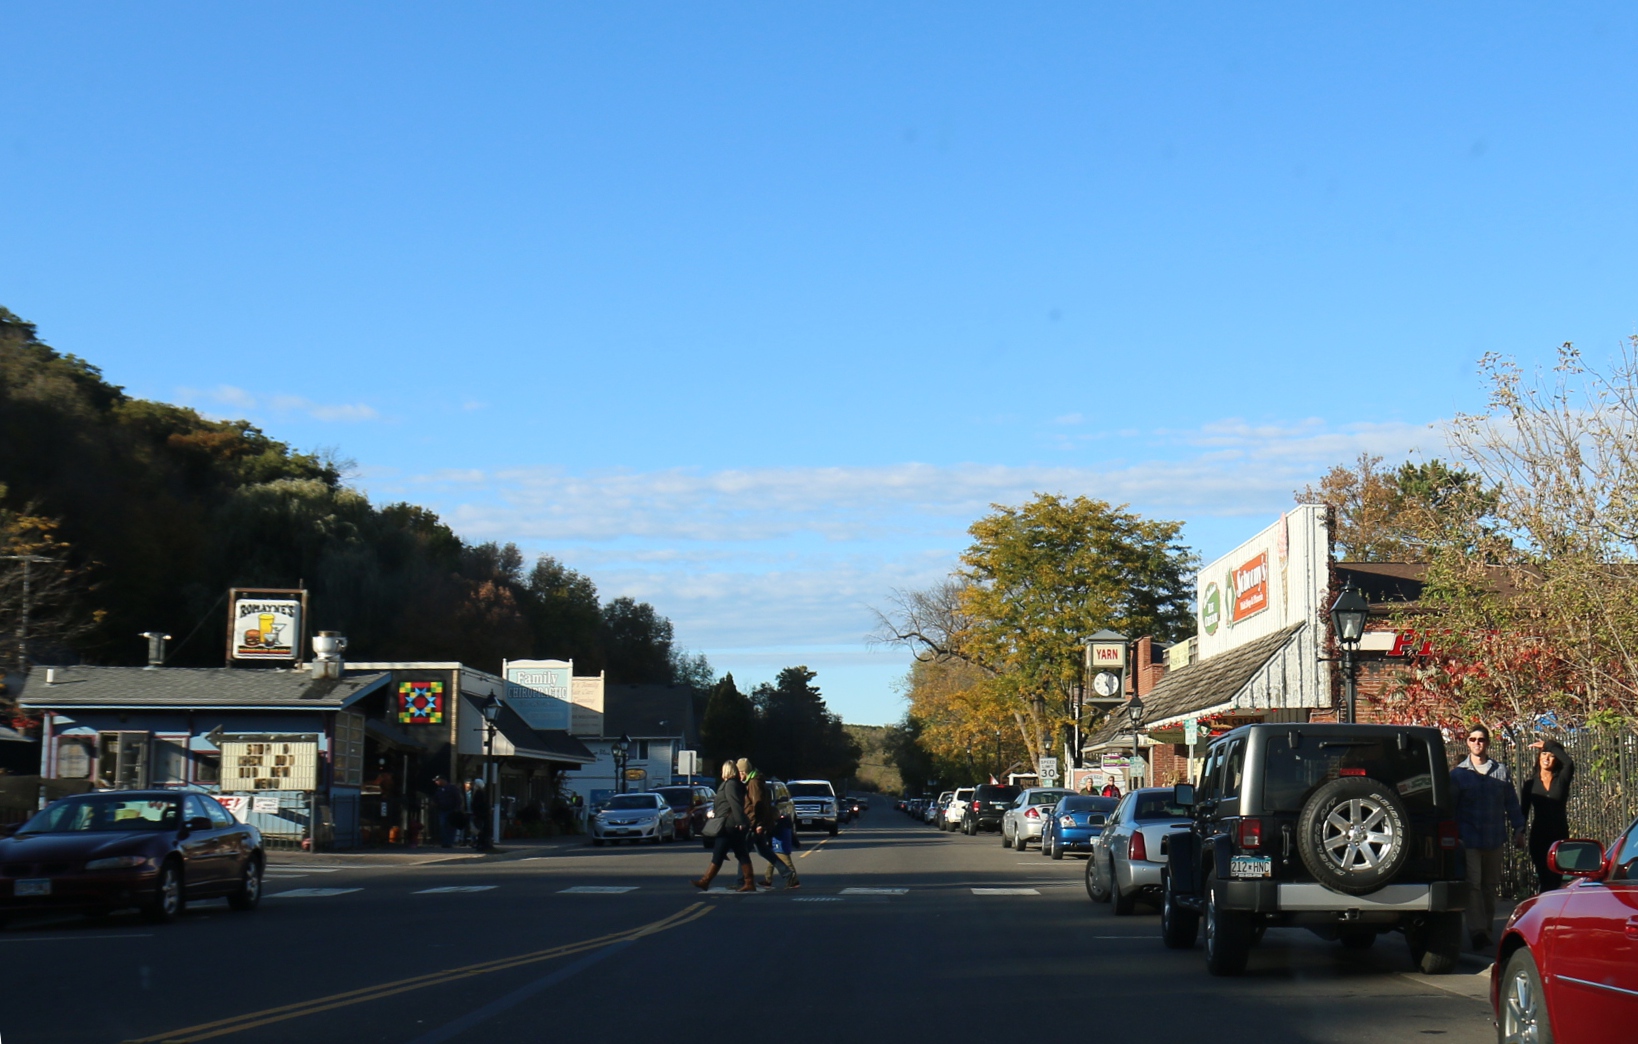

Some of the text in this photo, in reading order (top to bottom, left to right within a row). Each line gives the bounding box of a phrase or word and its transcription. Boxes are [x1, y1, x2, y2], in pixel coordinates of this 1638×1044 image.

[240, 604, 294, 618] ROMAYNE'S
[1096, 649, 1118, 660] YARN
[516, 671, 558, 687] Family
[508, 687, 567, 698] CHIROPRACTIC
[1041, 769, 1055, 777] 30
[1369, 793, 1403, 875] BRIDGESTONE
